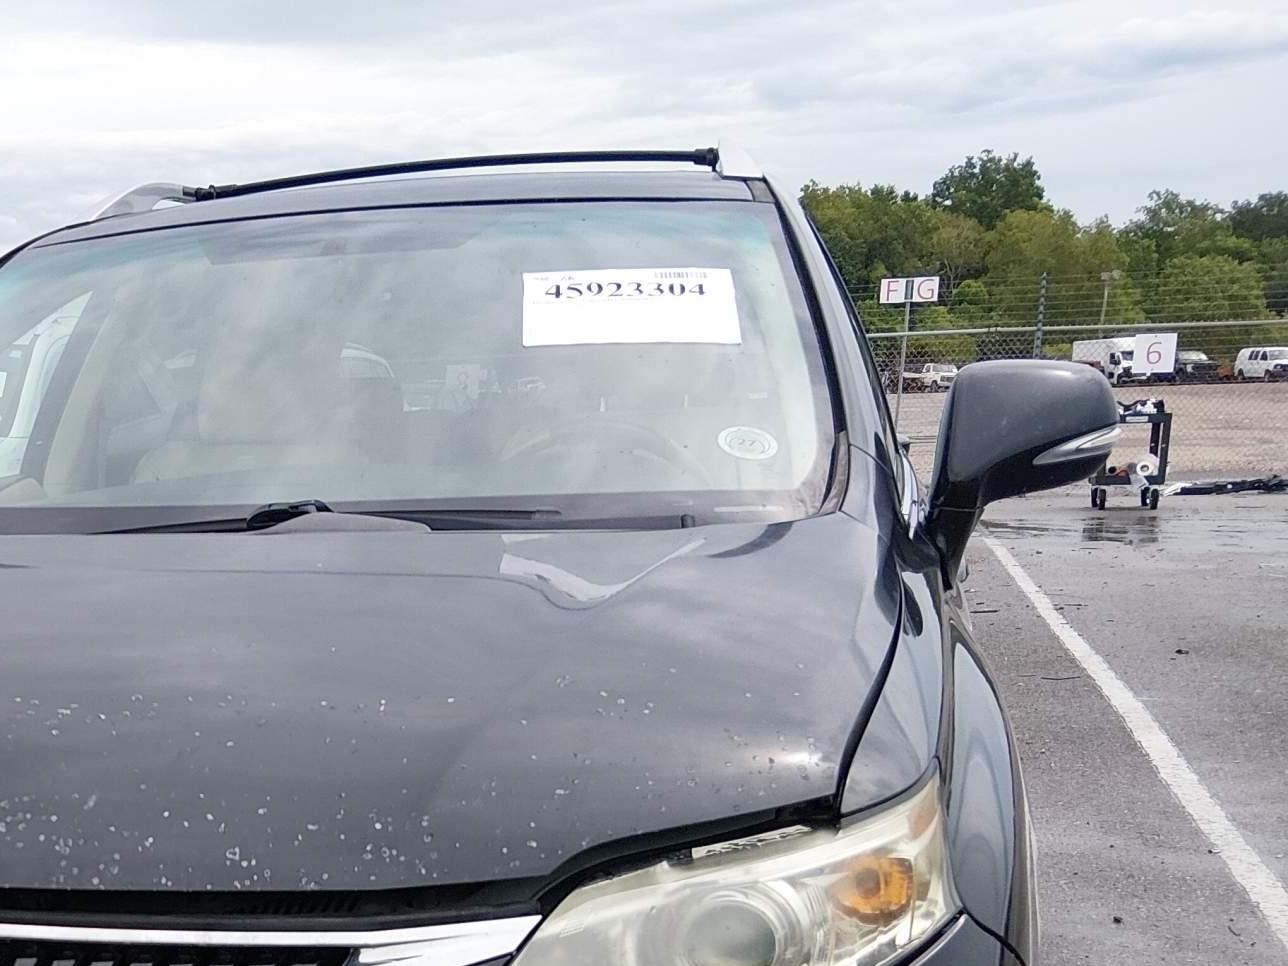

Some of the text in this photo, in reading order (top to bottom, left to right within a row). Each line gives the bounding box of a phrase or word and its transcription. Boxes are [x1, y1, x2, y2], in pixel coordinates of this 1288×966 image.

[544, 281, 707, 299] 45923304
[886, 278, 935, 301] F G
[1146, 341, 1162, 365] 6
